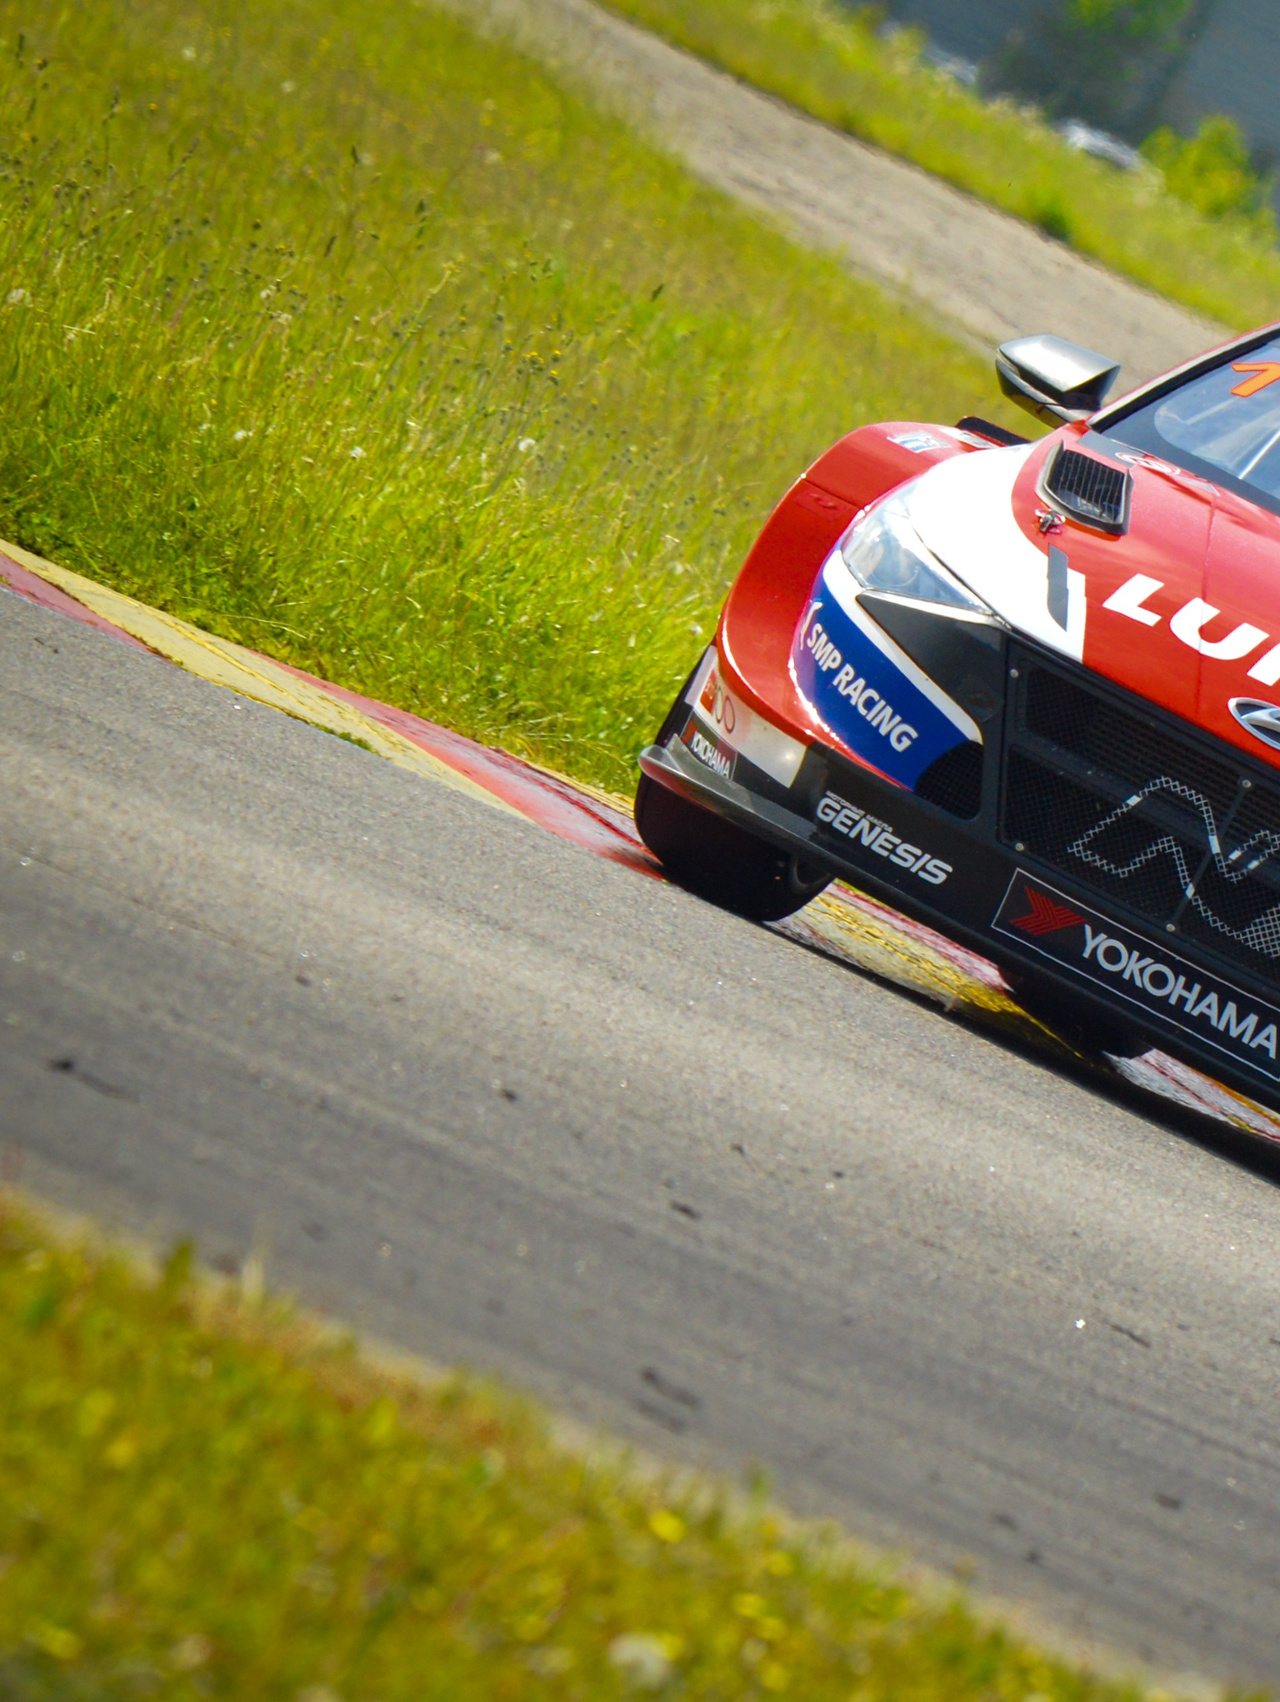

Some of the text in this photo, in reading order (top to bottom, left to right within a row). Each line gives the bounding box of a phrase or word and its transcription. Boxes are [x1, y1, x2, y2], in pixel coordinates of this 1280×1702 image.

[806, 623, 919, 752] SMP RACING
[816, 797, 954, 885] GENESIS
[1082, 923, 1278, 1059] YOKOHAMA
